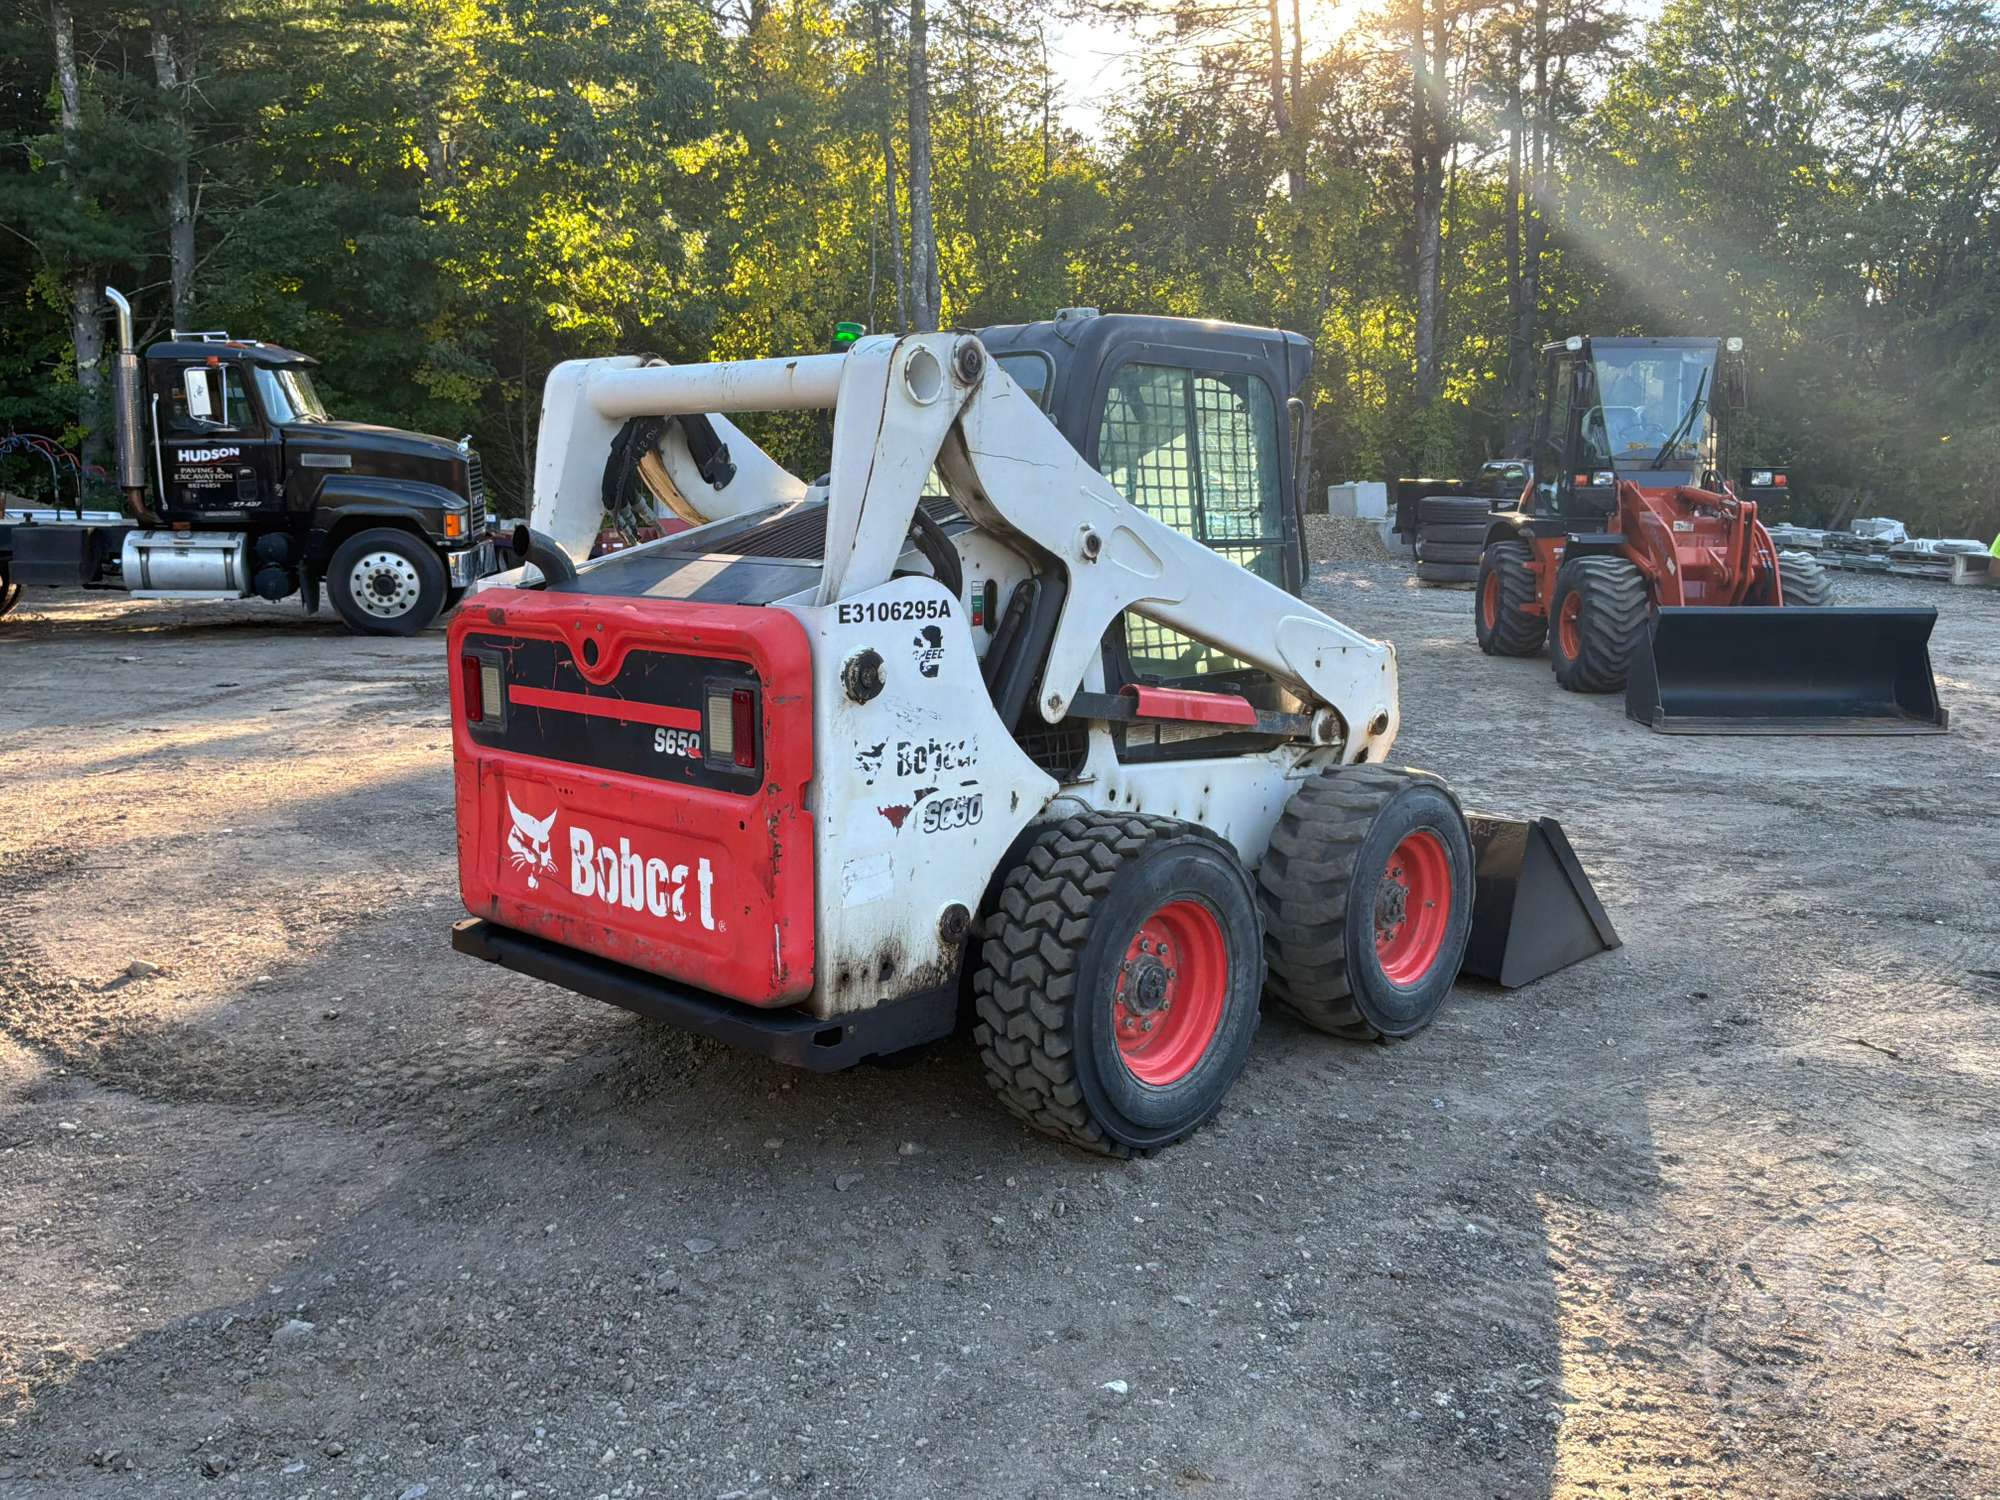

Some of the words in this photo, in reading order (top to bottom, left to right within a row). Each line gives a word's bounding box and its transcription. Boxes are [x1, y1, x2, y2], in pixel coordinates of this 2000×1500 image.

[178, 447, 240, 462] HUDSON
[838, 599, 951, 624] E3106295A
[654, 727, 701, 759] S650
[569, 826, 715, 931] Bobcat
